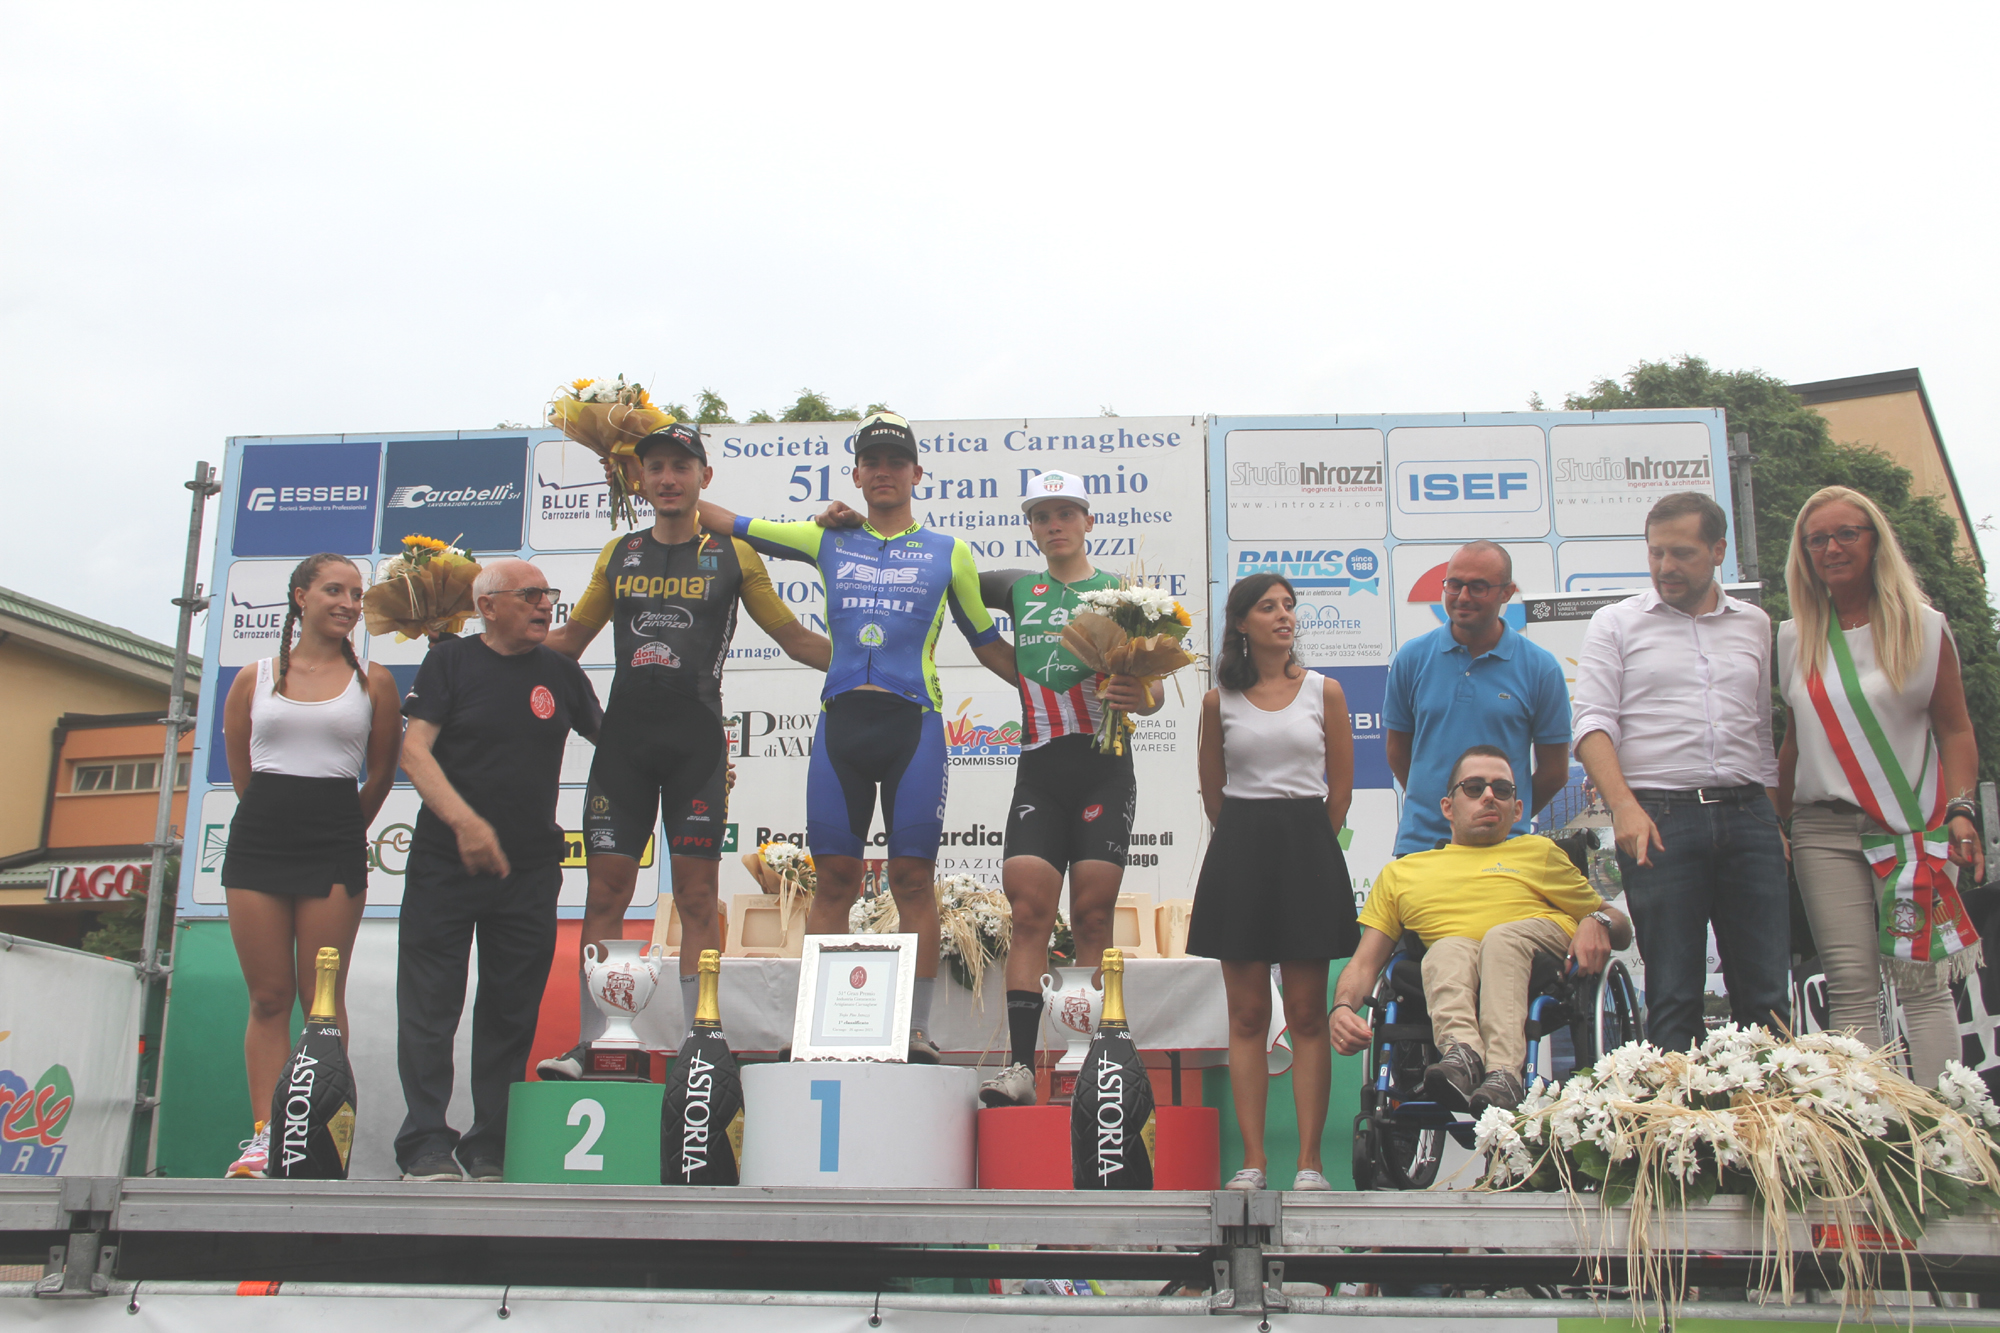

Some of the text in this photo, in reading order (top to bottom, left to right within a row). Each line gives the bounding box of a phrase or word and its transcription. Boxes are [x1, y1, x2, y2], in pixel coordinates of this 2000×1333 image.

[871, 428, 905, 439] DRALI
[723, 435, 829, 459] Società
[1004, 428, 1181, 453] Carnaghese
[789, 465, 850, 502] 51°
[911, 472, 998, 501] Gran
[1409, 472, 1527, 501] ISEF
[280, 486, 369, 502] ESSEBI
[402, 484, 511, 508] Carabelli
[543, 494, 589, 509] BLUE
[1230, 500, 1384, 509] www.introzzi.com
[541, 511, 590, 520] Carrozzeria
[922, 511, 1028, 530] Artigianat
[836, 547, 878, 562] Mondialpol
[890, 550, 933, 560] Rime
[1236, 550, 1344, 577] BANKS
[1351, 563, 1373, 571] 1988
[836, 582, 927, 595] segnaletica stradale
[842, 597, 914, 613] DRALI
[234, 614, 280, 628] BLUE
[1020, 601, 1070, 626] Za
[1295, 620, 1361, 629] SUPPORTER
[727, 646, 781, 660] arnago
[1358, 642, 1383, 650] (Varese)
[632, 654, 670, 666] camillo
[635, 649, 655, 659] don
[946, 712, 1022, 749] Varese
[1165, 720, 1176, 728] DI
[764, 744, 777, 757] di
[946, 746, 1022, 755] SPOR
[1133, 743, 1176, 752] VARESE
[683, 837, 713, 847] PVS
[1160, 831, 1173, 846] di
[282, 1044, 318, 1176] ASTORIA
[681, 1049, 715, 1183] ASTORIA
[1097, 1050, 1124, 1186] ASTORIA
[810, 1080, 841, 1172] 1
[563, 1098, 606, 1171] 2
